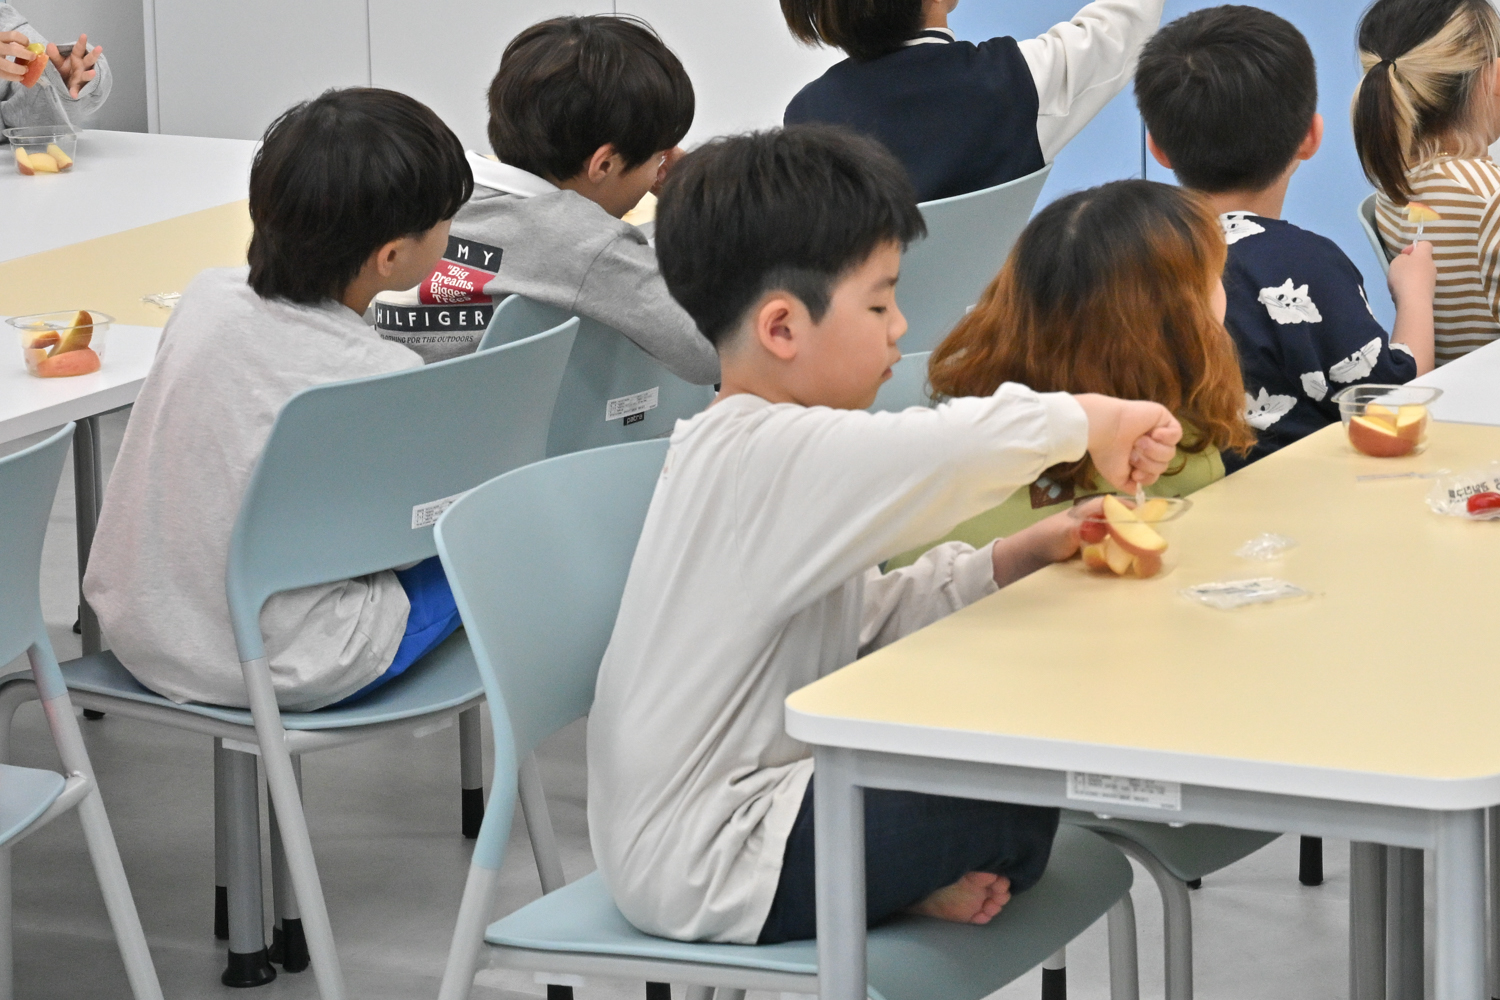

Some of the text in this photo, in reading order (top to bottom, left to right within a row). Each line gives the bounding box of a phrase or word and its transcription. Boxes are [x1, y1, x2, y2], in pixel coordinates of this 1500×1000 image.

[430, 282, 467, 298] Bigger
[431, 272, 474, 292] Dreams,
[377, 308, 484, 327] HILFIGER
[407, 335, 421, 344] FOR
[421, 335, 436, 343] THE
[436, 335, 474, 343] OUTDOORS
